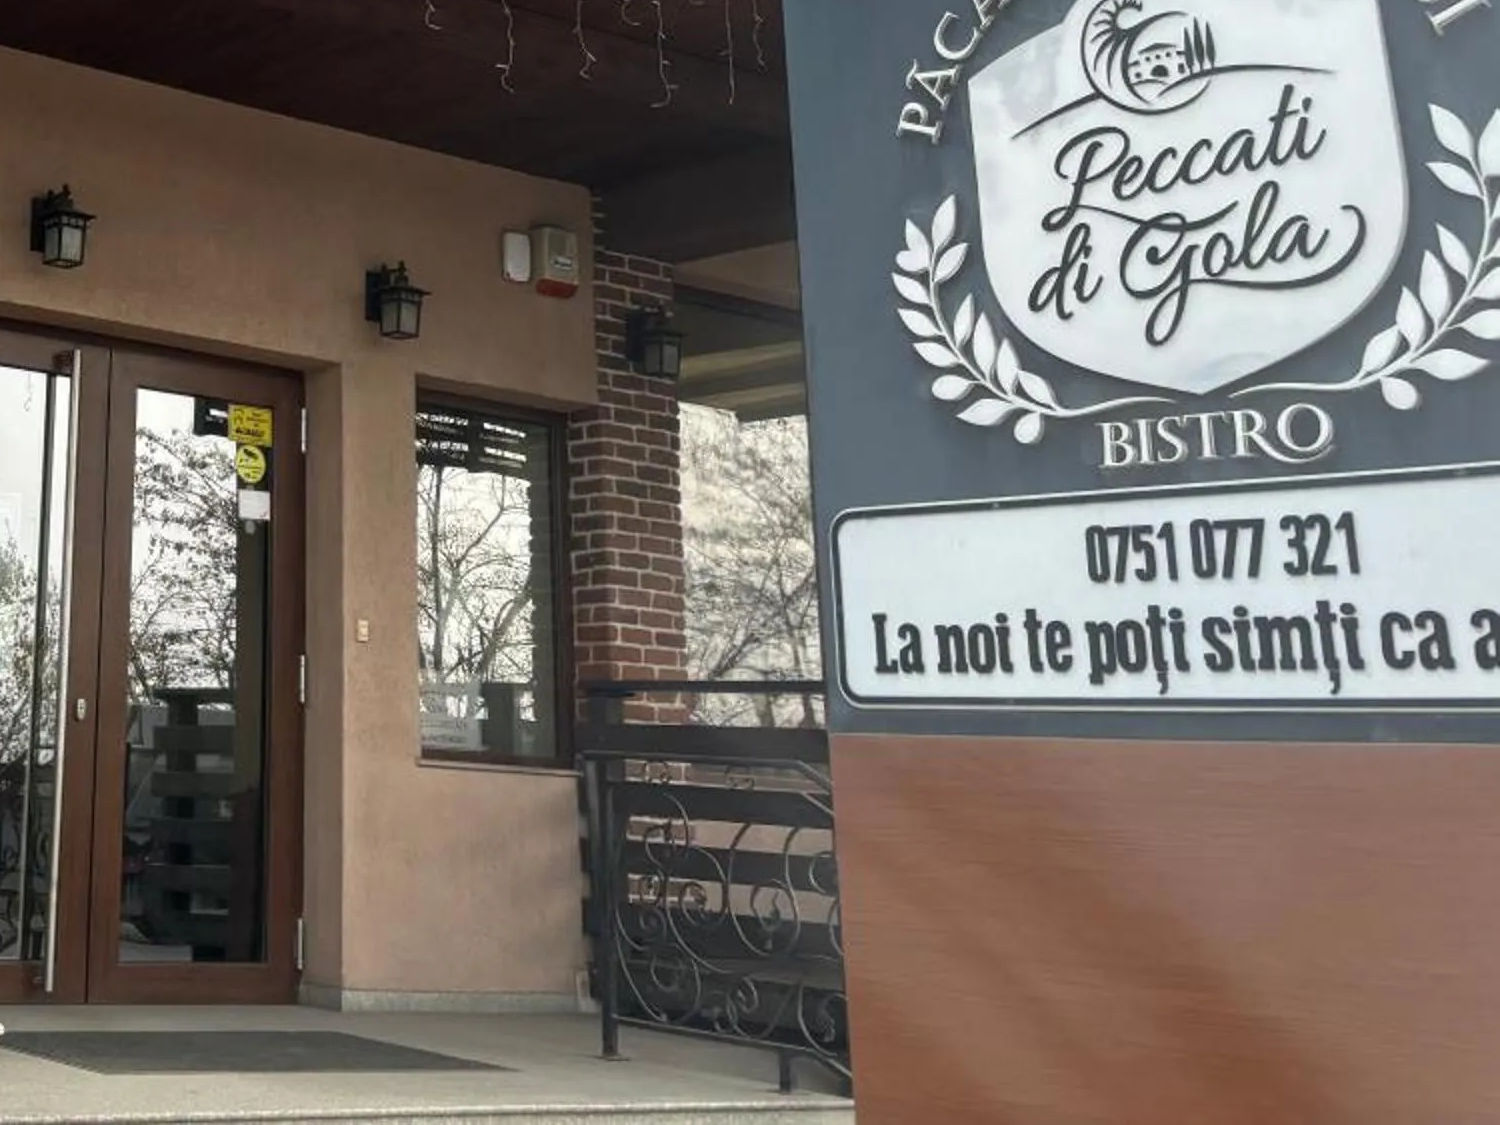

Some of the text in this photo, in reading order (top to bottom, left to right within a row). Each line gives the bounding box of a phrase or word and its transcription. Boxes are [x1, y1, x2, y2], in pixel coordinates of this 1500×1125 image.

[1041, 84, 1328, 233] Peccati
[1026, 180, 1368, 346] di Gola
[1099, 403, 1336, 469] BISTRO
[1084, 510, 1361, 584] 0751 077 321
[871, 611, 926, 676] La
[934, 613, 1014, 675] noi
[1023, 608, 1074, 673] te
[1379, 610, 1457, 673] ca
